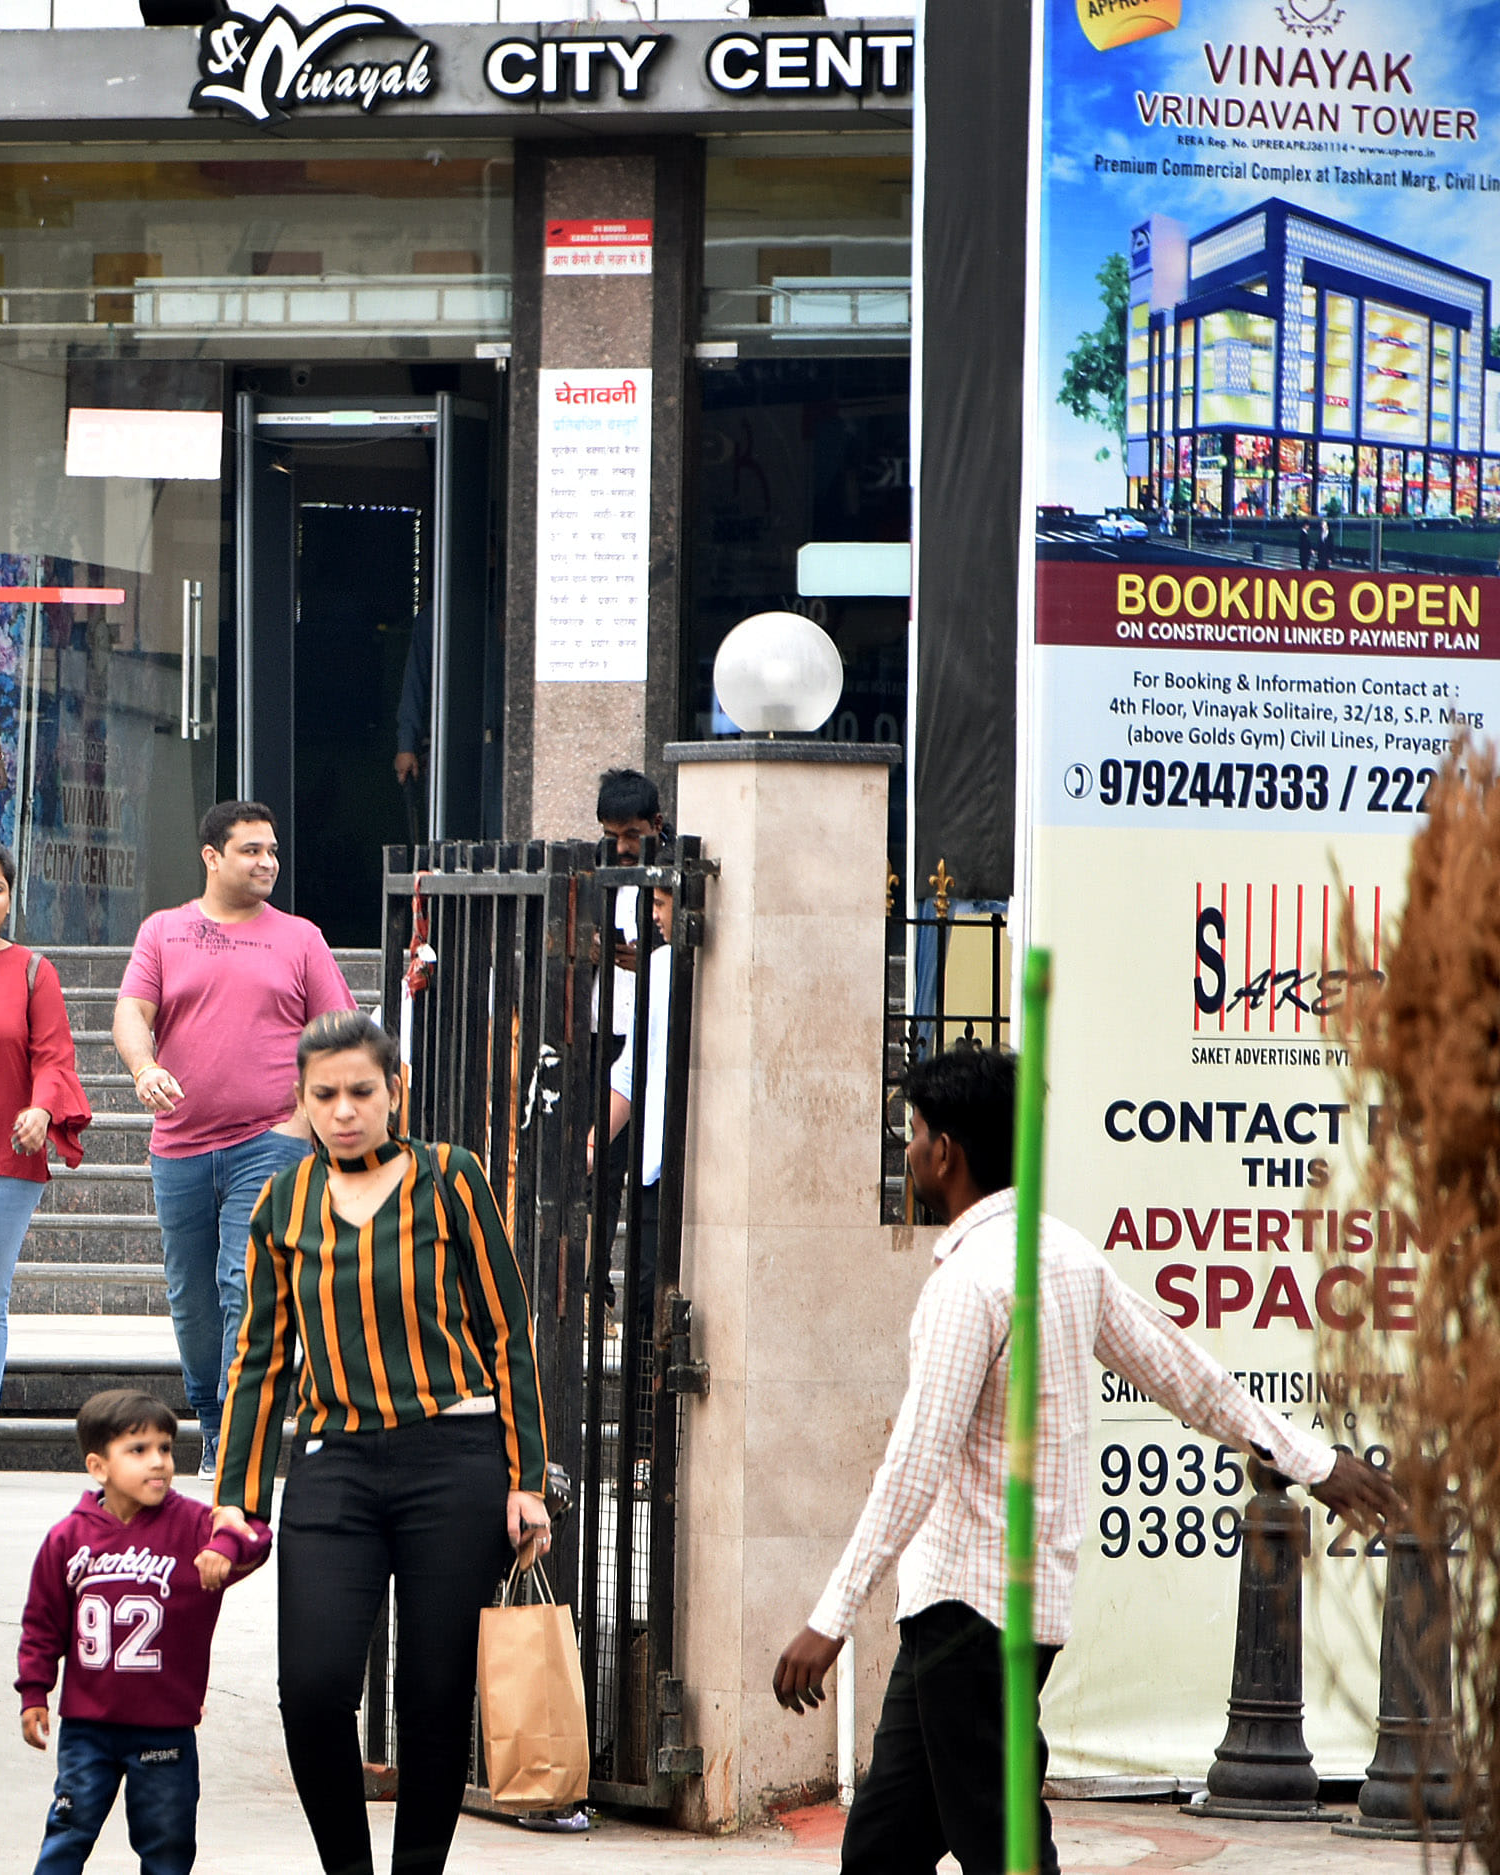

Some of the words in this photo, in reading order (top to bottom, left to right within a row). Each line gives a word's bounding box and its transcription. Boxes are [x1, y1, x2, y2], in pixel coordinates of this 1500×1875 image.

[200, 12, 431, 120] Vinayak
[487, 41, 658, 94] CITY
[1204, 43, 1414, 95] VINAYAK
[1137, 92, 1341, 133] VRINDAVAN
[1352, 104, 1478, 140] TOWER
[1094, 154, 1158, 175] Premium
[1162, 158, 1247, 180] Commercial
[1251, 162, 1312, 184] Complex
[1315, 168, 1330, 183] at
[1334, 166, 1397, 187] Tashkant
[1445, 171, 1476, 191] Civil
[555, 380, 637, 404] चेतावनी
[1116, 573, 1336, 622] BOOKING
[1349, 580, 1480, 628] OPEN
[1116, 622, 1145, 640] ON
[1148, 622, 1280, 644] CONSTRUCTION
[1284, 627, 1345, 646] LINKED
[1349, 629, 1429, 649] PAYMENT
[1433, 632, 1481, 651] PLAN
[1133, 671, 1160, 689] For
[1164, 672, 1232, 694] Booking
[1237, 674, 1250, 692] &
[1255, 674, 1357, 695] Information
[1362, 677, 1428, 697] Contact
[1432, 682, 1449, 698] at
[1109, 698, 1136, 715] 4th
[1142, 699, 1188, 719] Floor,
[1192, 700, 1258, 722] Vinayak
[1263, 702, 1339, 723] Solitaire,
[1343, 703, 1399, 725] 32/18,
[1404, 706, 1433, 724] S.P.
[1439, 708, 1484, 729] Marg
[1127, 725, 1184, 747] (above
[1188, 727, 1236, 746] Golds
[1240, 728, 1285, 750] Gym)
[1290, 730, 1326, 748] Civil
[1331, 731, 1379, 752] Lines,
[62, 786, 124, 829] VINAYAK
[1099, 758, 1329, 810] 9792447333
[1338, 766, 1358, 812] /
[43, 842, 77, 882] CITY
[81, 846, 137, 888] CENTRE
[1192, 1047, 1231, 1065] SAKET
[1235, 1048, 1320, 1066] ADVERTISING
[1104, 1099, 1350, 1145] CONTACT
[1242, 1157, 1329, 1188] THIS
[1104, 1207, 1434, 1254] ADVERTISIN
[1155, 1264, 1419, 1331] SPACE
[67, 1545, 176, 1598] Brooklyn
[77, 1594, 164, 1672] 92
